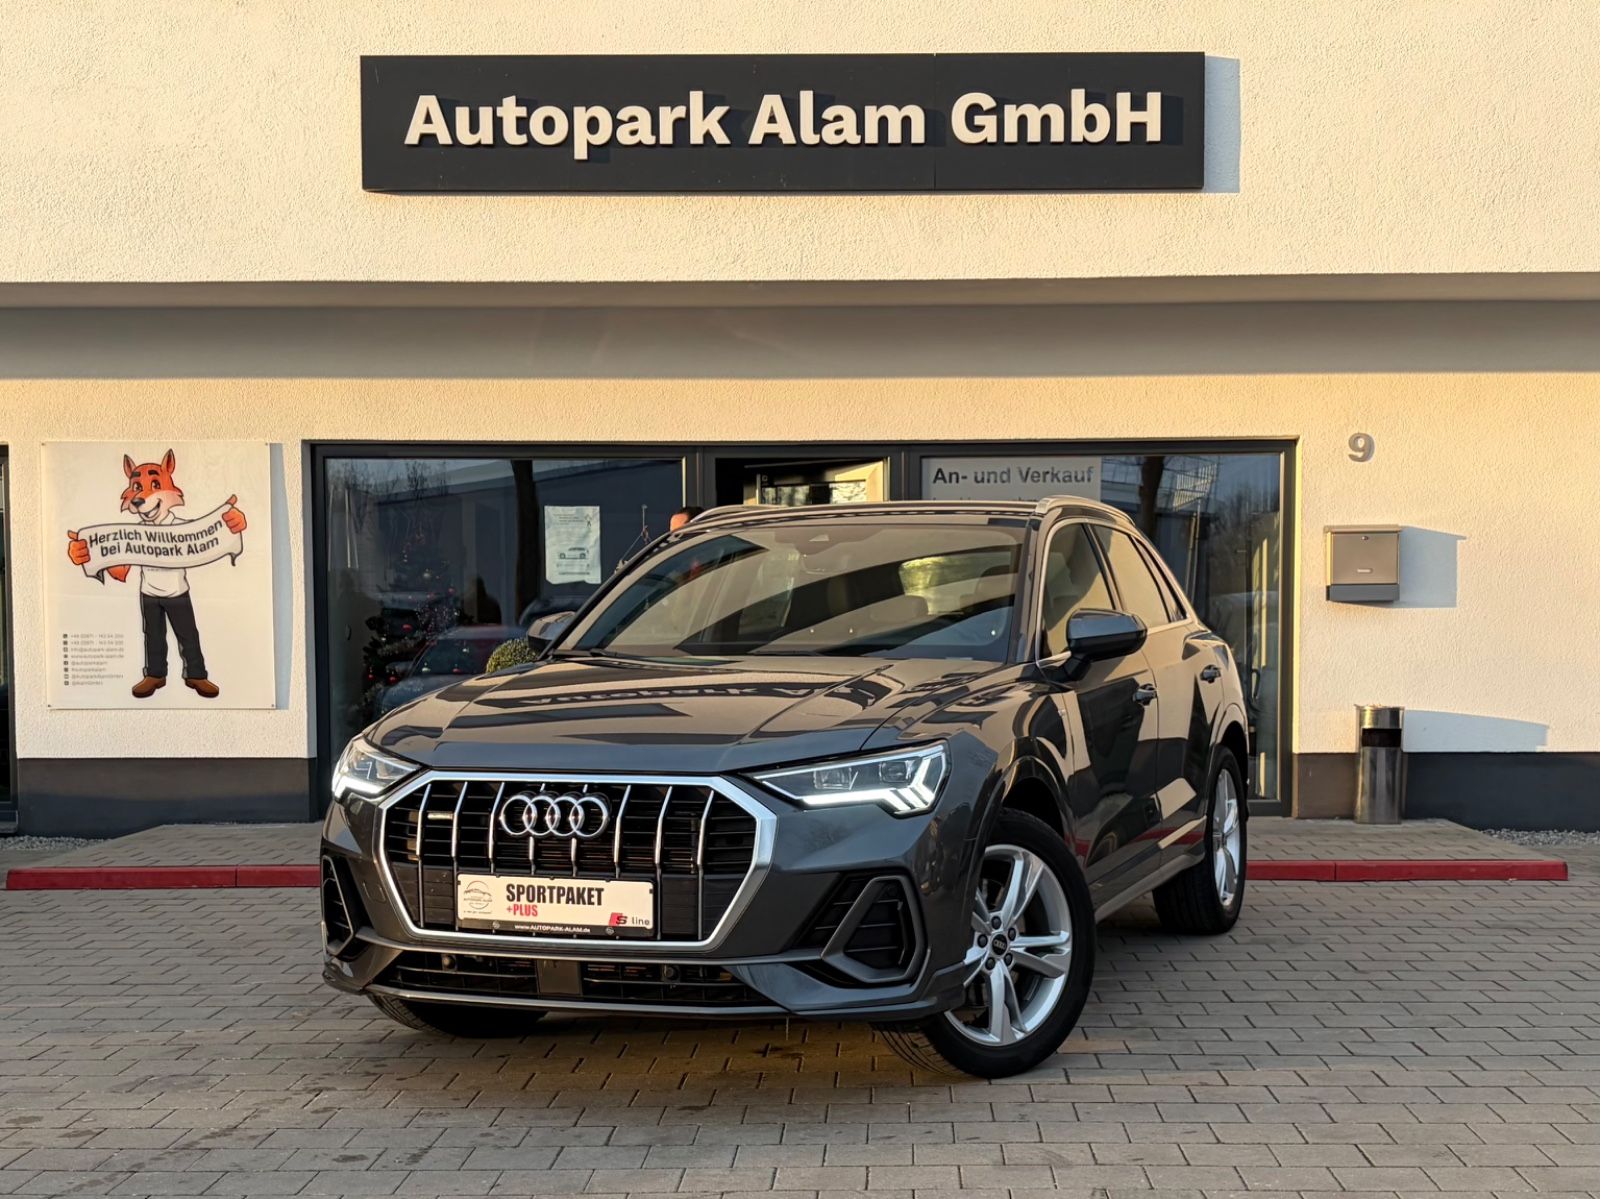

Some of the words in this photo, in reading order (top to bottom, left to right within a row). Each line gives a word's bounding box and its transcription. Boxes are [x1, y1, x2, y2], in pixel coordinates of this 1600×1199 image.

[404, 90, 731, 160] Autopark
[748, 90, 926, 145] Alam
[951, 88, 1161, 144] GmbH
[1348, 432, 1375, 463] 9
[932, 467, 967, 484] An-
[974, 467, 1011, 484] und
[1018, 466, 1094, 484] Verkauf
[89, 529, 142, 548] Herzlich
[145, 519, 223, 544] Willkommen
[100, 543, 121, 557] bei
[125, 542, 183, 558] Autopark
[187, 536, 219, 555] Alam
[506, 883, 604, 906] SPORTPAKET
[507, 904, 538, 917] +PLUS
[631, 916, 650, 926] line
